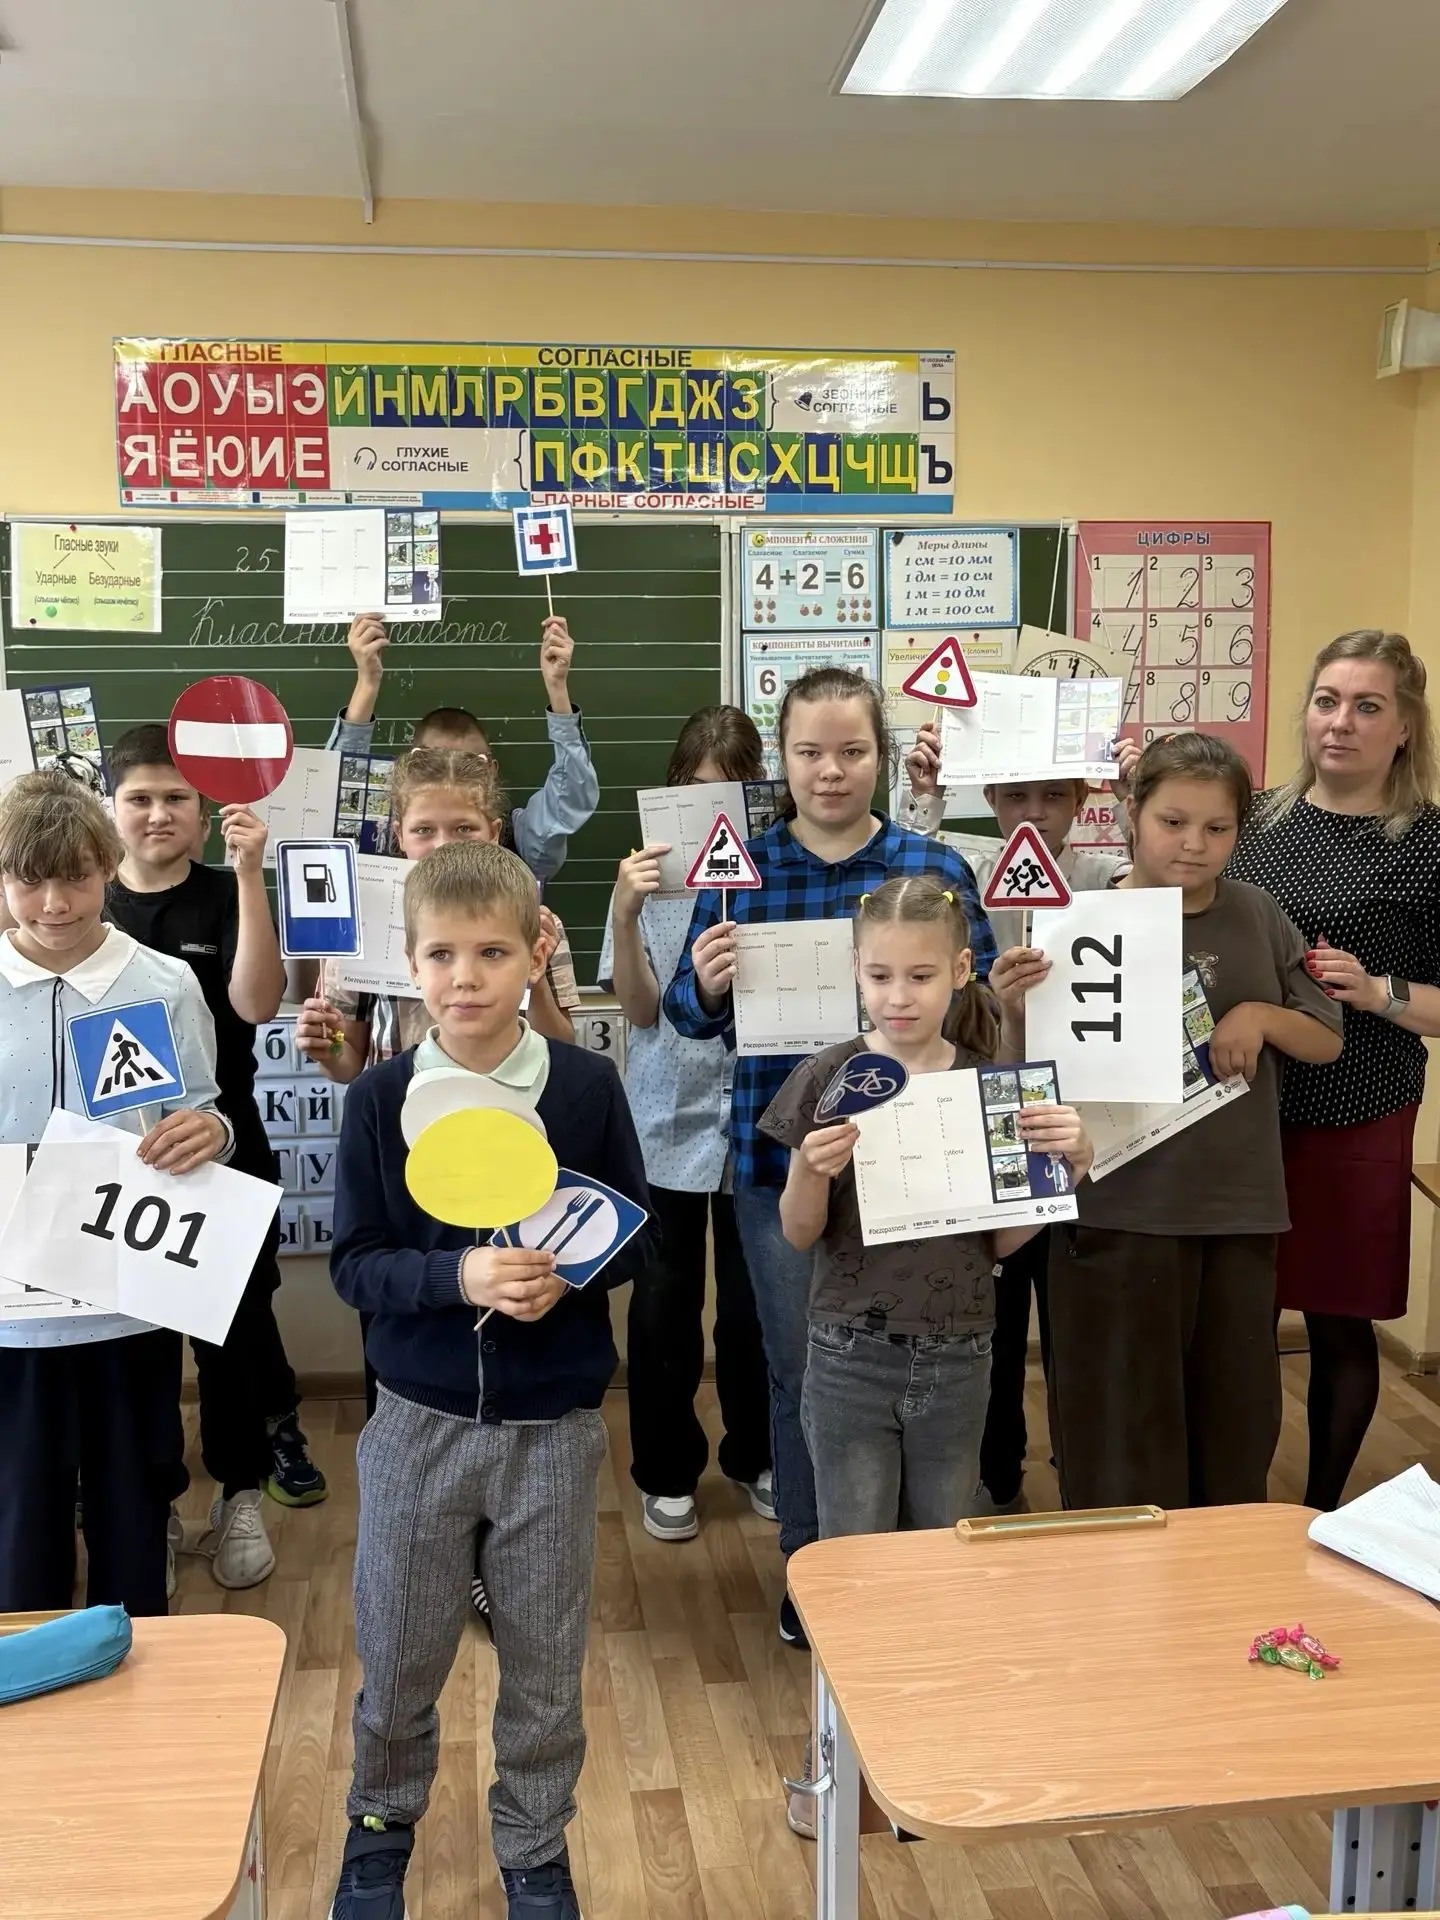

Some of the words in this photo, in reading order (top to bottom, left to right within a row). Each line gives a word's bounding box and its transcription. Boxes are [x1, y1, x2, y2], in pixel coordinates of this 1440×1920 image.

[160, 343, 283, 363] ГЛАСНЫЕ
[538, 348, 692, 368] СОГЛАСНЫЕ
[396, 446, 449, 460] ГЛУХИЕ
[381, 459, 469, 473] СОГЛАСНЫЕ
[634, 494, 755, 509] СОГЛАСНЫЕ
[54, 534, 93, 552] Гласные
[94, 539, 119, 557] звуки
[765, 536, 817, 544] МПОНЕНТЫ
[819, 535, 868, 544] СЛОЖЕНИЯ
[917, 541, 949, 552] Меры
[952, 540, 988, 550] длины
[1137, 532, 1210, 547] ЦИФРЫ
[915, 557, 934, 566] см
[968, 555, 993, 565] мм
[35, 570, 77, 587] Ударные
[89, 571, 141, 589] Безударные
[915, 570, 936, 583] дм
[973, 571, 993, 581] см
[965, 586, 986, 598] дм
[975, 604, 995, 615] см
[889, 652, 928, 662] Увеличи
[1076, 807, 1117, 824] ТАБ
[1071, 934, 1123, 1043] 112
[81, 1182, 207, 1269] 101
